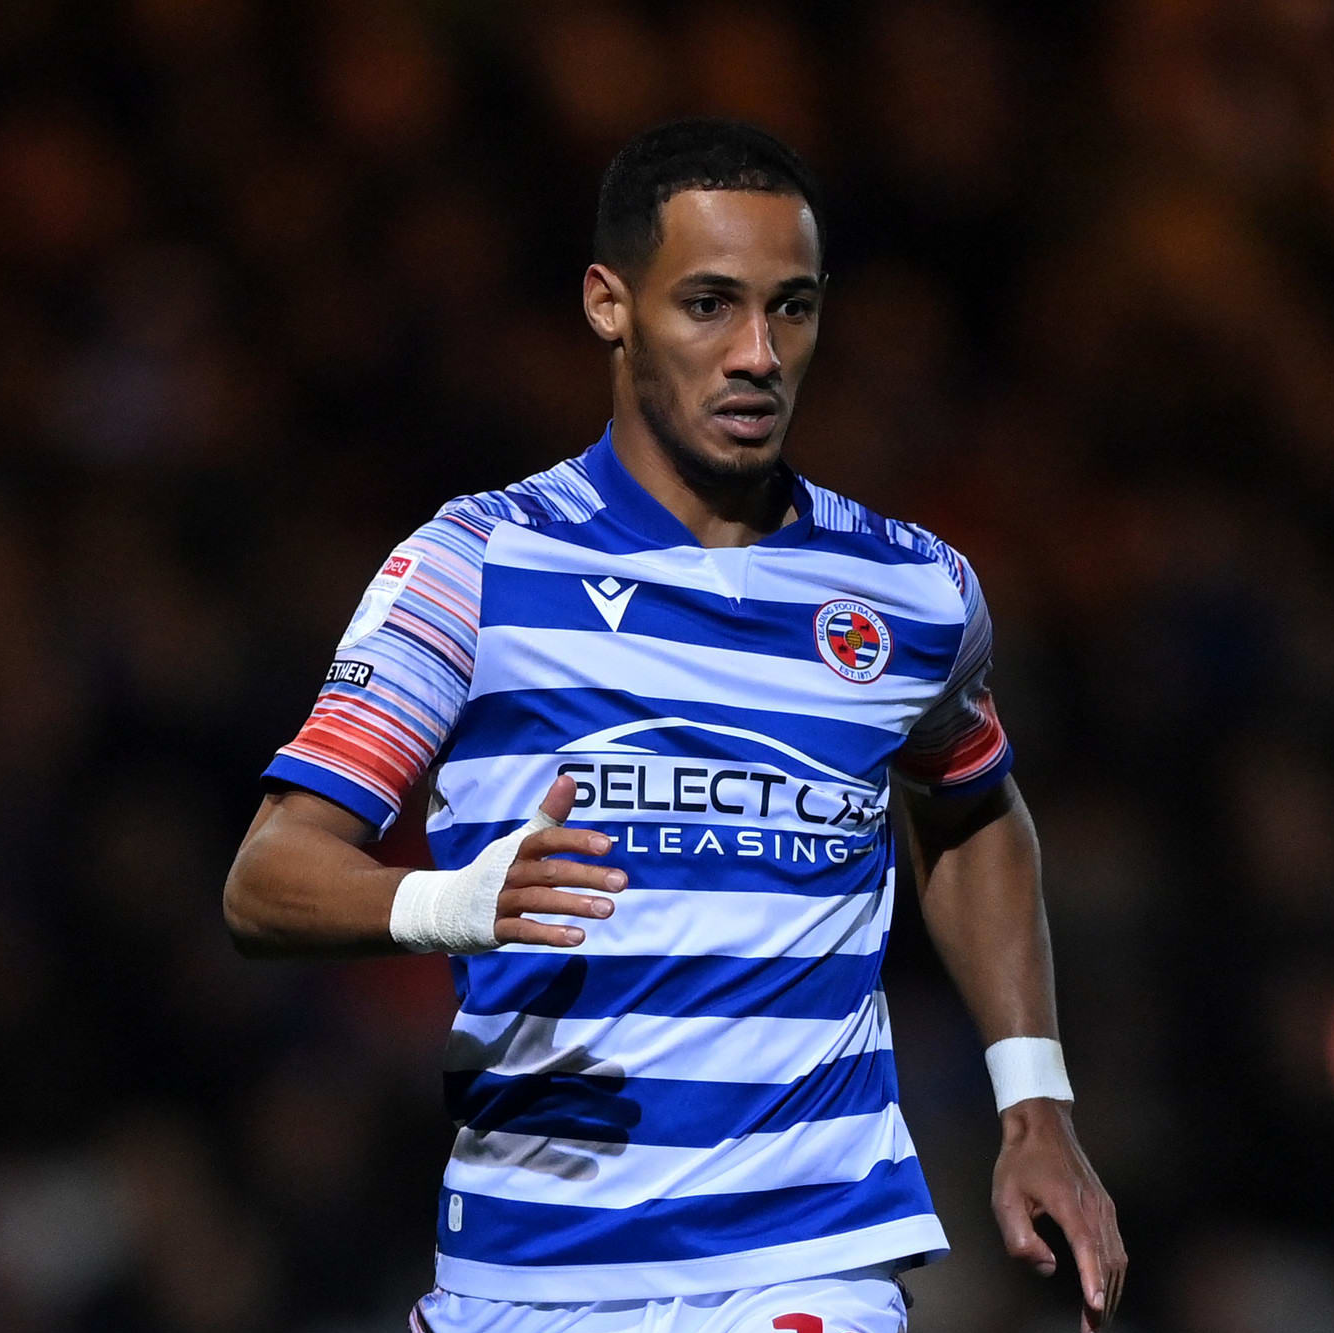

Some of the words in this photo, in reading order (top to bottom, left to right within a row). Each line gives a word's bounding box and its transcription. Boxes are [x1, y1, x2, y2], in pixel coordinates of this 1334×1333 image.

[818, 606, 834, 641] READING
[833, 603, 879, 628] FOOTBALL
[878, 626, 889, 652] CLUB
[558, 763, 786, 817] SELECT
[627, 827, 849, 864] LEASING
